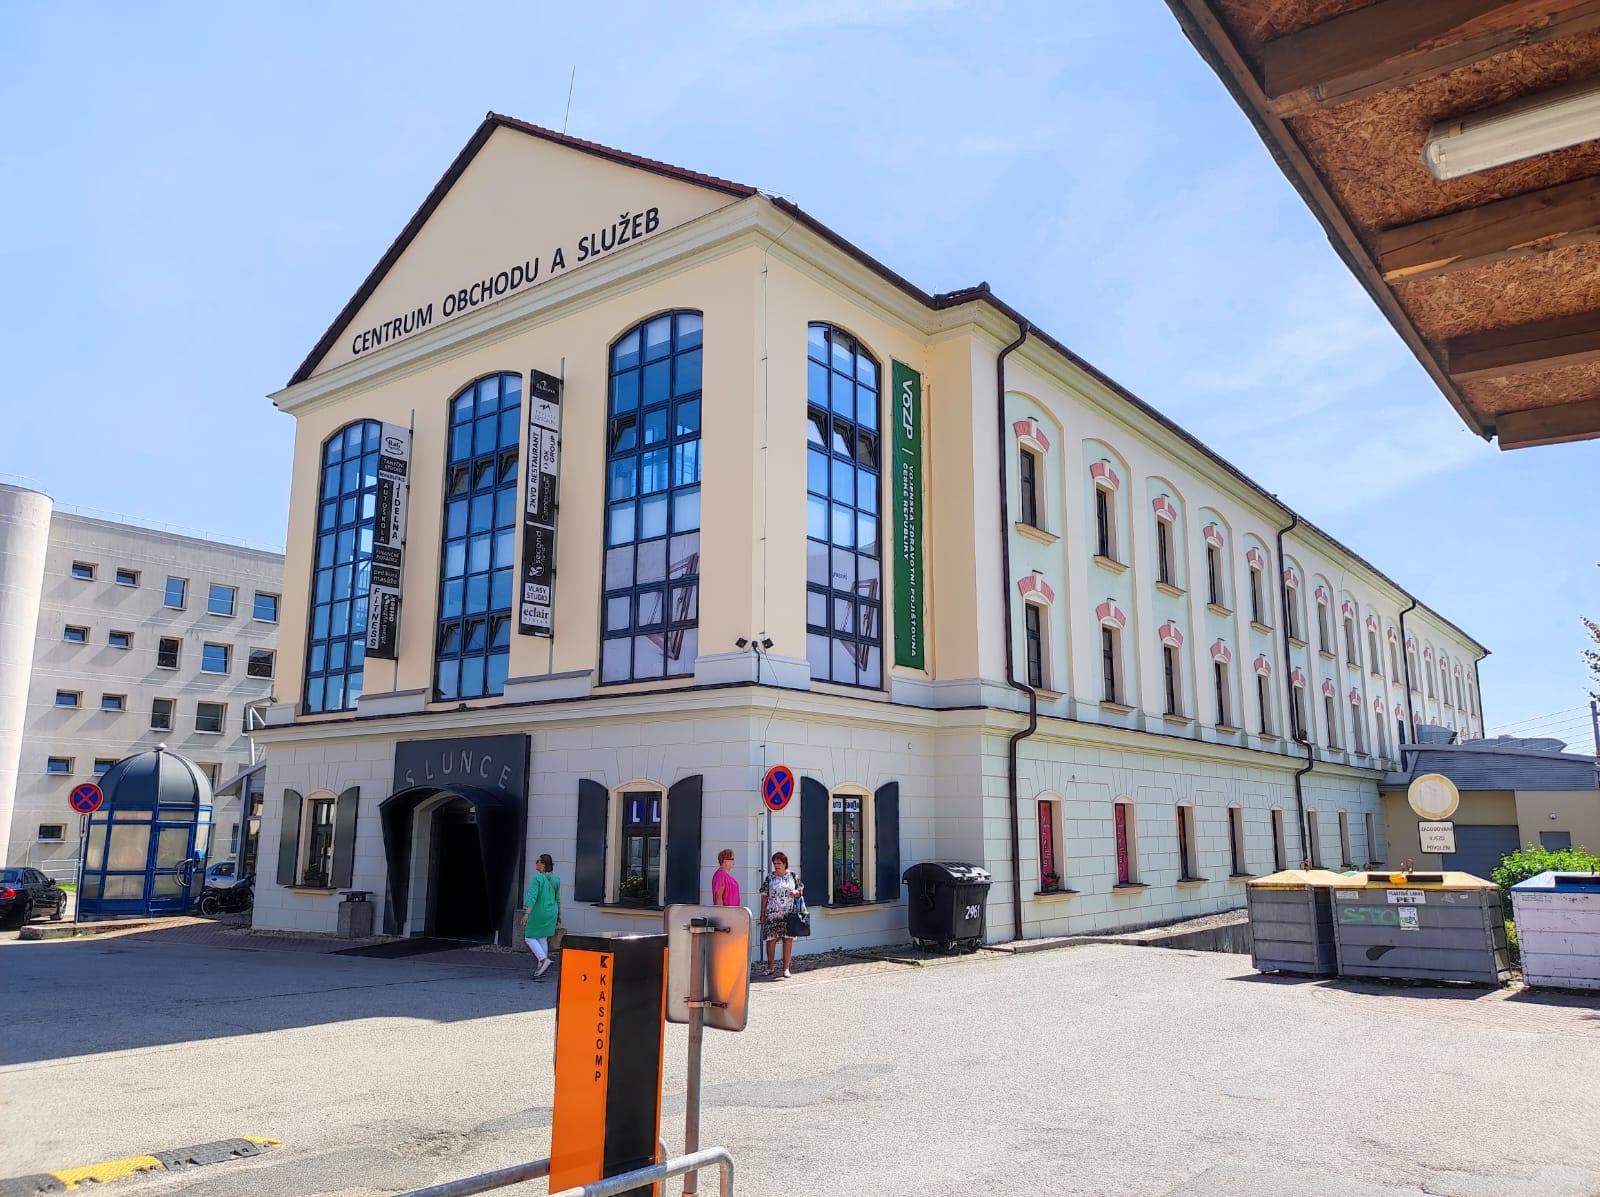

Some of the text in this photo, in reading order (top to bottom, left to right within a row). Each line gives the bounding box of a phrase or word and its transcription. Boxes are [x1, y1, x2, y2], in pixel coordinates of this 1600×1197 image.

[352, 207, 660, 355] CENTRUM OBCHODU A SLUŽEB
[902, 380, 913, 439] VOZP
[531, 431, 540, 483] RESTAURANT
[543, 450, 549, 461] OK
[526, 592, 548, 601] STUDIO
[528, 586, 547, 594] VLASY
[369, 587, 381, 647] FITNESS
[523, 607, 550, 619] eclair
[405, 750, 511, 790] SLUNCE
[632, 800, 661, 822] L L
[965, 904, 980, 920] 2961
[594, 974, 606, 1082] KASCOMP
